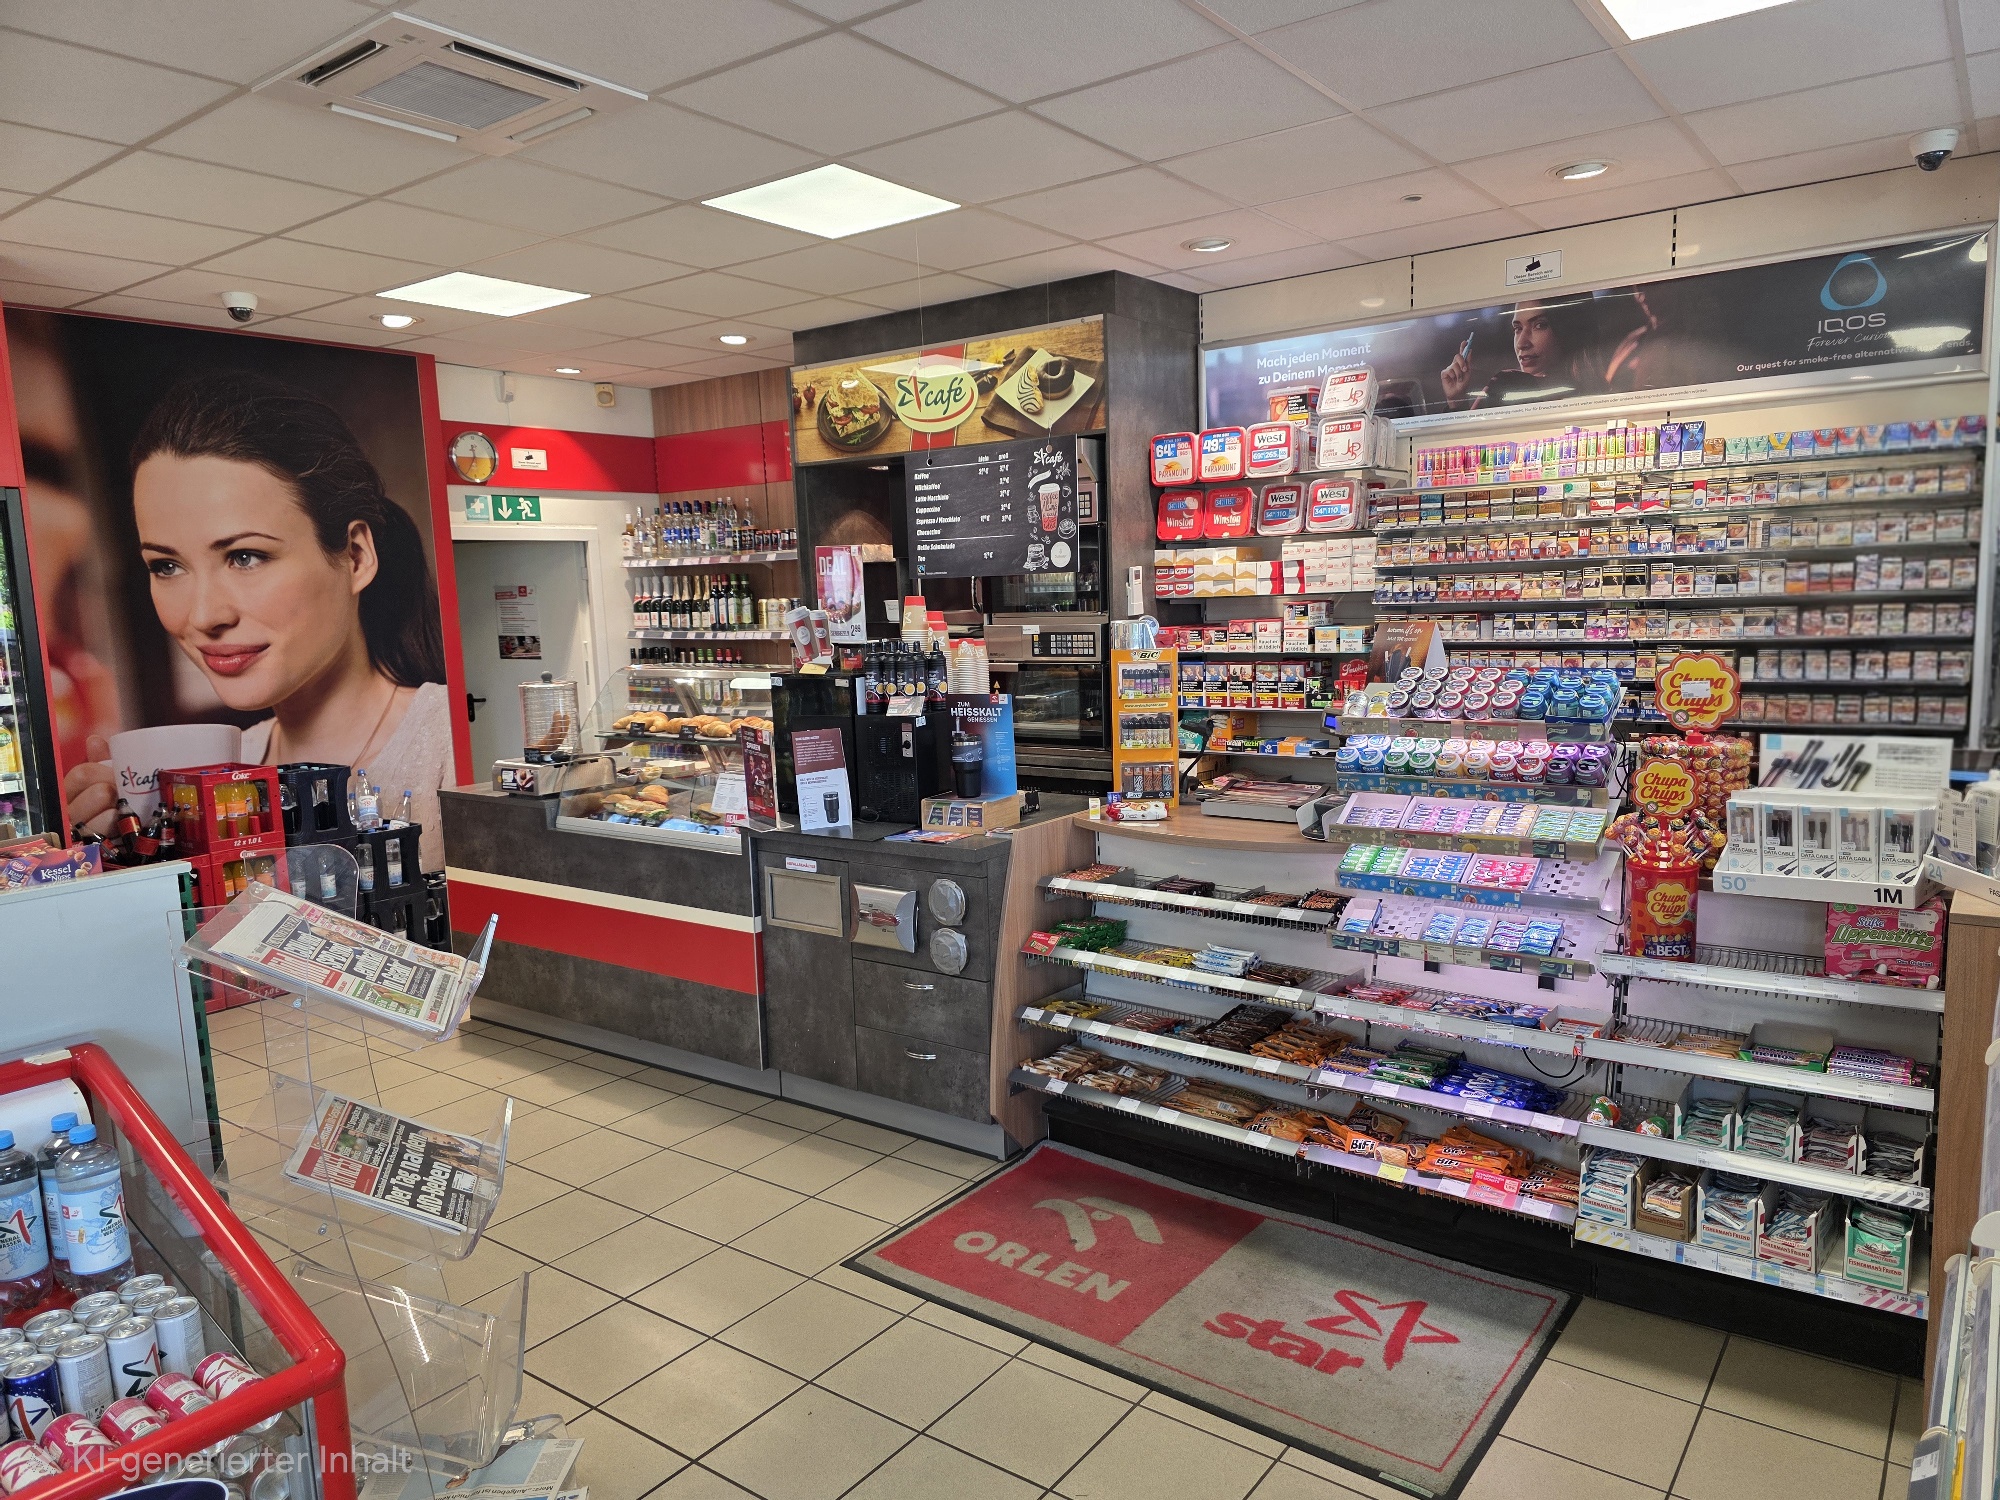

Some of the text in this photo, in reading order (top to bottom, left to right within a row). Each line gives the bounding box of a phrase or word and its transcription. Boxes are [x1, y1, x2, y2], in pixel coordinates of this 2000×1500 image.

[1818, 312, 1887, 334] IQOS
[1807, 330, 1891, 351] Forever Curiou
[1257, 343, 1371, 369] Mach jeden Moment
[1737, 364, 1753, 373] Our
[1755, 360, 1781, 372] quest
[1783, 358, 1796, 367] for
[1799, 352, 1853, 365] smoke-free
[1258, 370, 1315, 385] zu Deinem
[924, 377, 966, 415] café
[1257, 432, 1283, 443] West
[1045, 451, 1064, 468] café
[1158, 468, 1190, 478] PARAMOUNT
[1204, 463, 1236, 473] PARAMOUNT
[1270, 493, 1294, 503] West
[1320, 489, 1347, 499] West
[1167, 517, 1193, 527] Winston
[1213, 514, 1240, 524] Winston
[818, 556, 847, 576] DEAL
[1139, 652, 1159, 661] BIC
[950, 707, 1002, 717] HEISSKALT
[232, 771, 251, 781] Coke
[1643, 773, 1688, 788] Chupa
[1641, 786, 1686, 801] Chups
[234, 839, 241, 847] 12
[41, 864, 72, 880] Kessel
[1928, 863, 1943, 881] 24
[1721, 876, 1746, 891] 50
[1652, 892, 1687, 903] Chupa
[1873, 888, 1902, 904] 1M
[1651, 902, 1686, 916] Chups
[1856, 916, 1885, 929] Süße
[1831, 924, 1936, 946] Lippenstifte
[282, 939, 318, 958] CDU
[1656, 944, 1687, 957] BEST
[314, 950, 350, 969] SPD
[1350, 1140, 1376, 1152] BiFi
[389, 1167, 422, 1190] Tag
[409, 1159, 460, 1214] AfD-Beben
[383, 1184, 414, 1206] Der
[1582, 1197, 1626, 1213] FISHERMAN'S FRIEND
[1638, 1212, 1684, 1229] FISHERMAN'S FRIEND
[1703, 1225, 1751, 1241] FISHERMAN'S FRIEND
[1761, 1240, 1810, 1258] FISHERMAN'S FRIEND
[953, 1230, 1132, 1302] ORLEN
[1848, 1259, 1903, 1276] FISHERMAN'S FRIEND
[1202, 1312, 1365, 1375] star
